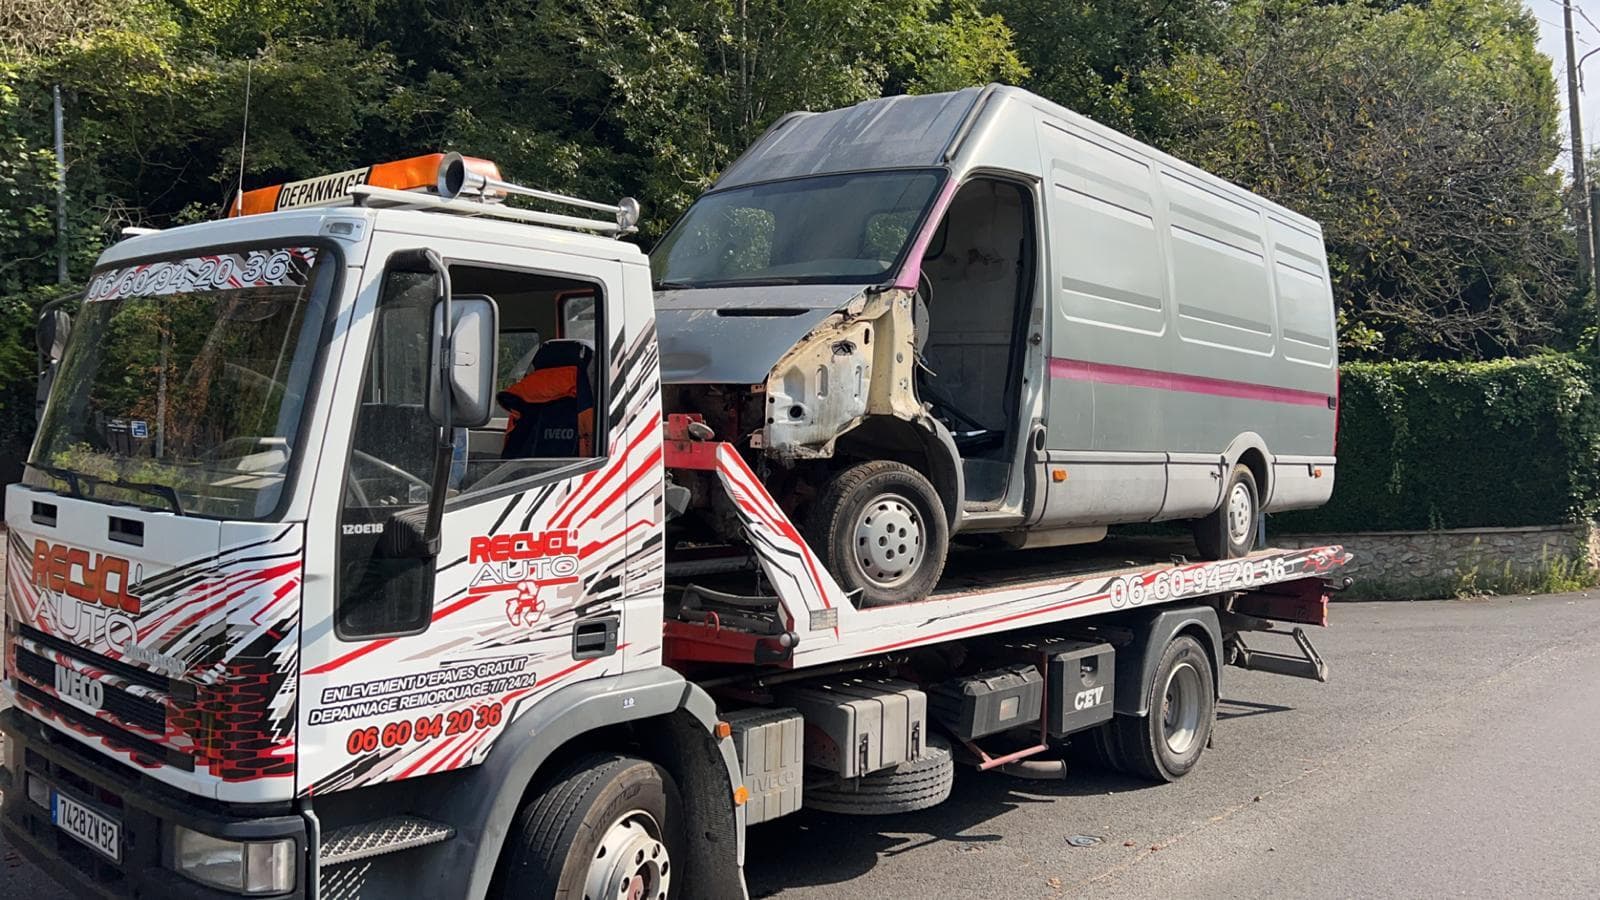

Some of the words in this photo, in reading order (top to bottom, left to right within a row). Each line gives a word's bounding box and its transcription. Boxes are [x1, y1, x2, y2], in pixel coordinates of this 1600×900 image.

[280, 172, 366, 208] DEPANNAGE
[119, 269, 150, 295] 60
[154, 264, 188, 290] 94
[194, 258, 234, 287] 20
[242, 252, 291, 282] 36
[544, 428, 574, 440] IVECO
[342, 523, 384, 535] 120E18
[469, 555, 579, 586] AUTO
[1110, 576, 1145, 608] 06
[1154, 568, 1185, 600] 60
[1193, 565, 1222, 594] 94
[1229, 560, 1254, 588] 20
[1261, 557, 1287, 583] 36
[31, 588, 138, 651] AUTO
[55, 664, 104, 710] IVECO
[308, 700, 397, 726] DEPANNAGE
[399, 683, 489, 710] REMORQUAGE
[489, 679, 507, 694] 7/7
[507, 673, 537, 692] 24/24
[321, 677, 415, 705] ENLEVEMENT
[417, 665, 476, 691] D'EPAVES
[477, 656, 528, 679] GRATUIT
[1074, 686, 1104, 711] CEV
[347, 727, 378, 755] 06
[382, 720, 412, 748] 60
[414, 714, 443, 742] 94
[445, 708, 473, 736] 20
[475, 703, 502, 729] 36
